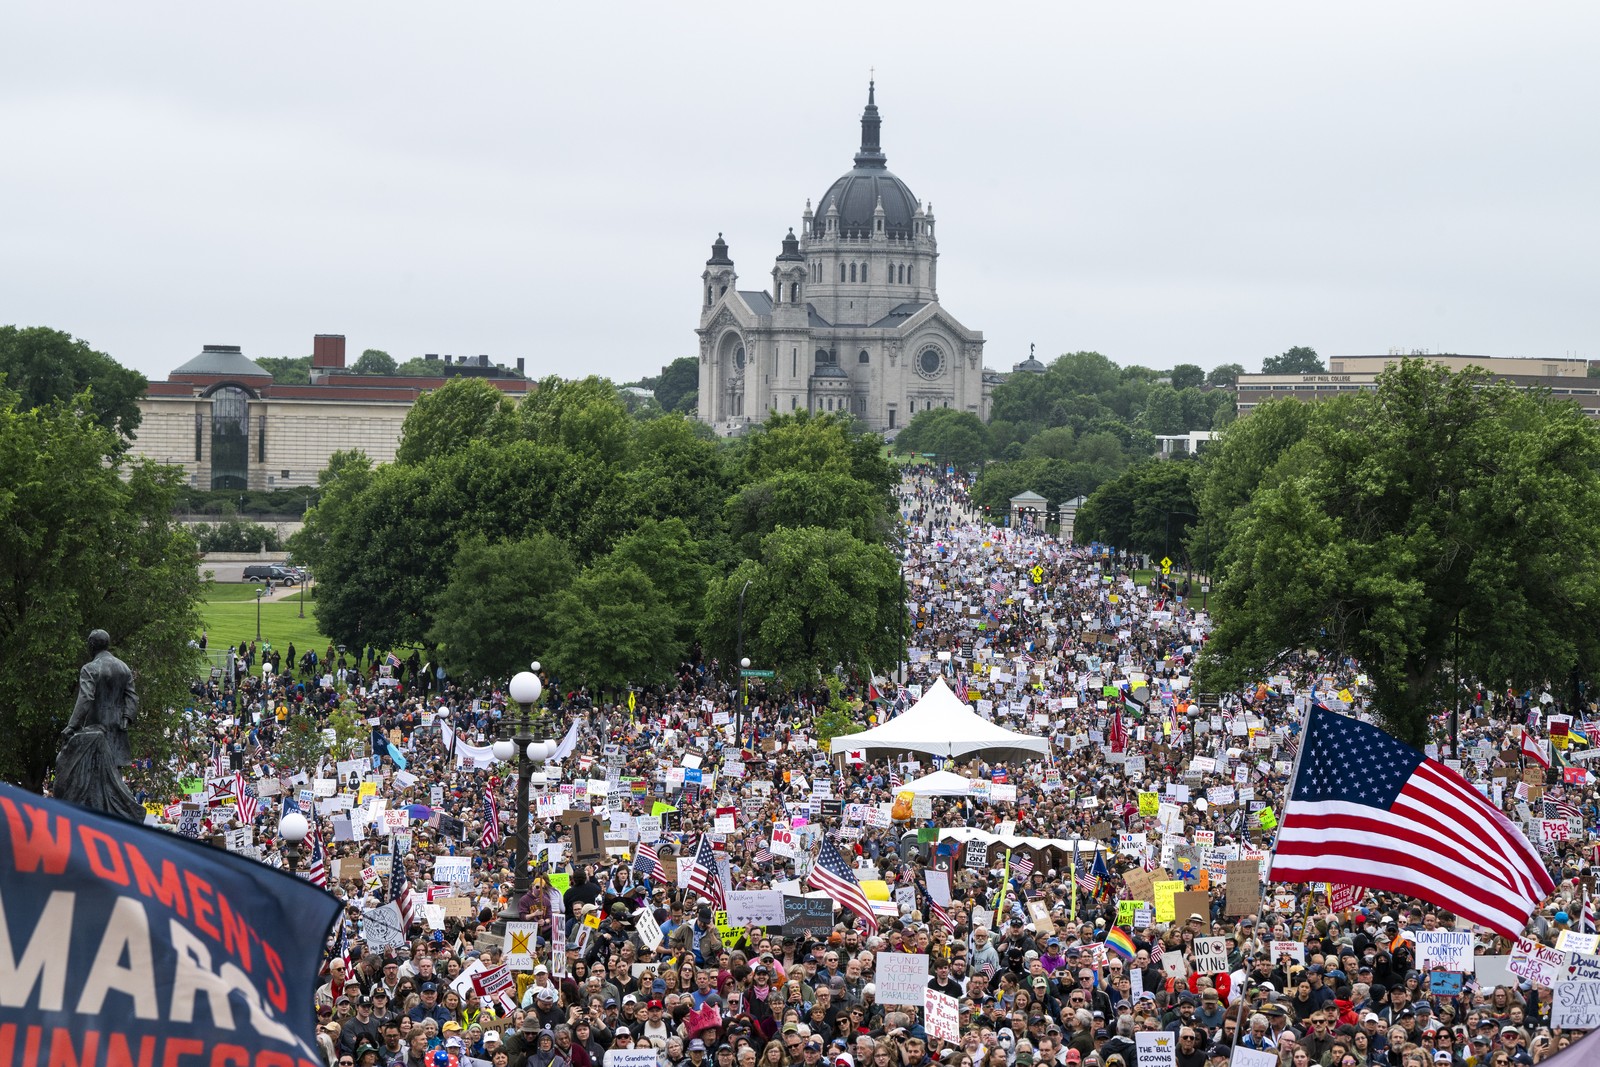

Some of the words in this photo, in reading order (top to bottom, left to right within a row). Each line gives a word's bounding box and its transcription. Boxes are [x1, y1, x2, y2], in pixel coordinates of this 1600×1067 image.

[180, 823, 197, 832] OUR
[1543, 822, 1568, 830] FUCK
[773, 830, 791, 844] NO
[1545, 831, 1567, 840] ICE
[436, 866, 456, 875] PROFIT
[458, 866, 470, 874] OVER
[0, 796, 288, 1013] WOMEN'S
[784, 899, 807, 909] Good
[1417, 932, 1470, 946] CONSTITUTION
[1517, 939, 1532, 952] NO
[1196, 942, 1209, 956] NO
[1427, 946, 1463, 956] COUNTRY
[506, 958, 530, 966] LASS
[890, 956, 920, 964] FUND
[1198, 957, 1226, 971] KING
[1432, 961, 1459, 971] PARTY
[1528, 958, 1542, 973] YES
[1571, 952, 1600, 969] DONAL
[884, 965, 923, 974] SCIENCE
[1510, 962, 1551, 986] QUEENS
[482, 973, 500, 985] DISSENT
[888, 973, 914, 982] NOT
[488, 977, 508, 992] PATRIOTIC
[881, 982, 924, 992] MILITARY
[882, 991, 918, 1000] PARADES
[926, 989, 938, 1000] So
[940, 994, 958, 1010] Much
[926, 1014, 950, 1030] Resist
[936, 1008, 958, 1023] Resist
[934, 1026, 960, 1043] Resist
[1236, 1048, 1270, 1067] Donald
